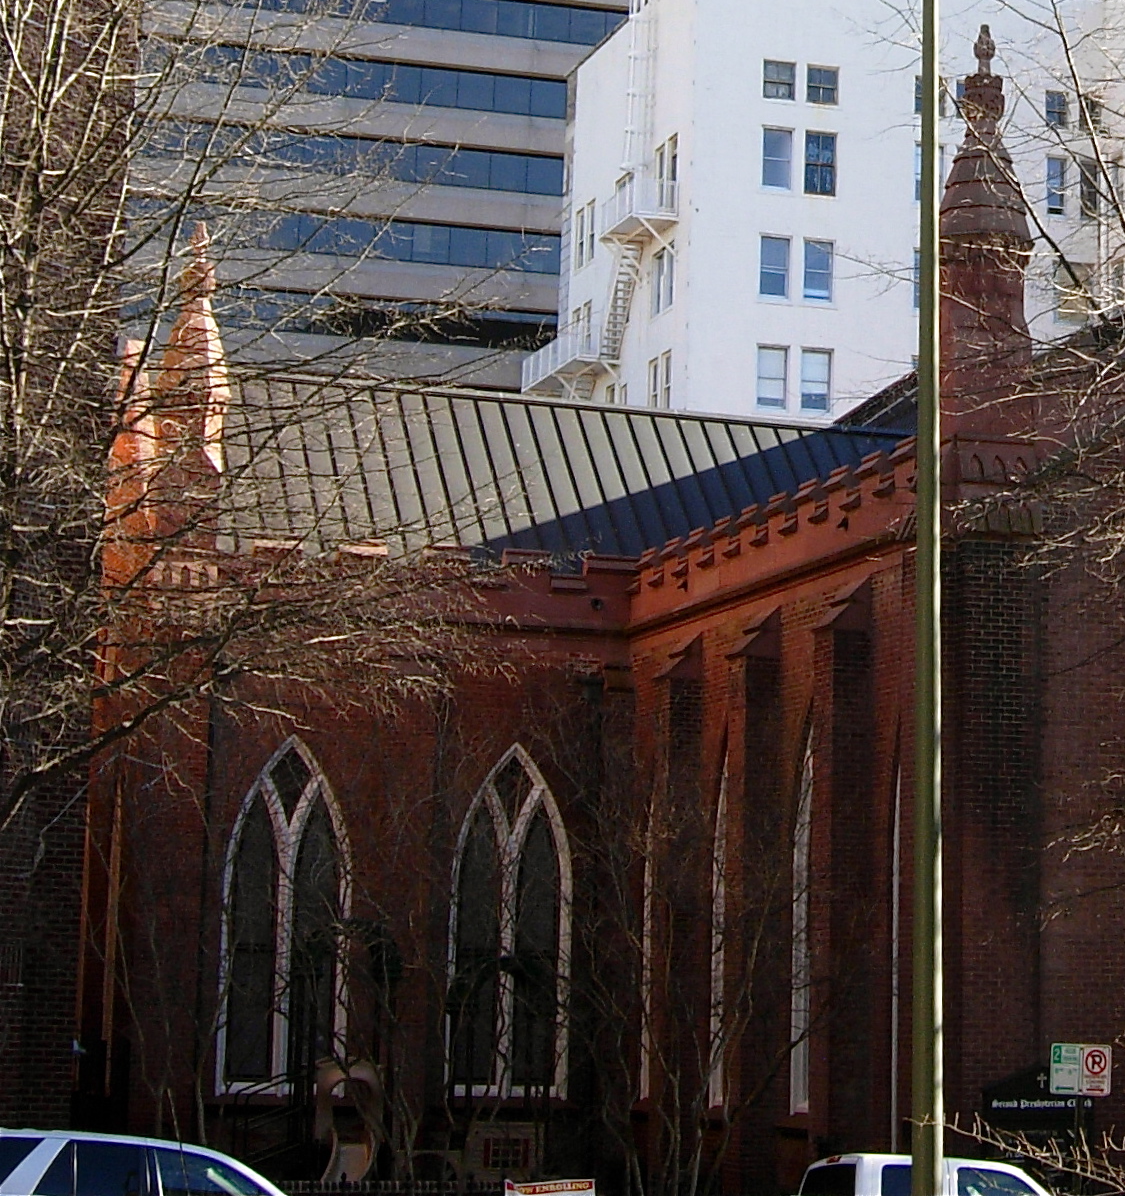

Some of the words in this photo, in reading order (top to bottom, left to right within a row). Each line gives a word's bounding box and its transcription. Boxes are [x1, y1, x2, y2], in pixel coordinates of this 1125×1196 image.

[1053, 1047, 1061, 1061] 2
[515, 1185, 534, 1195] OW
[535, 1182, 590, 1193] ENROLLING
